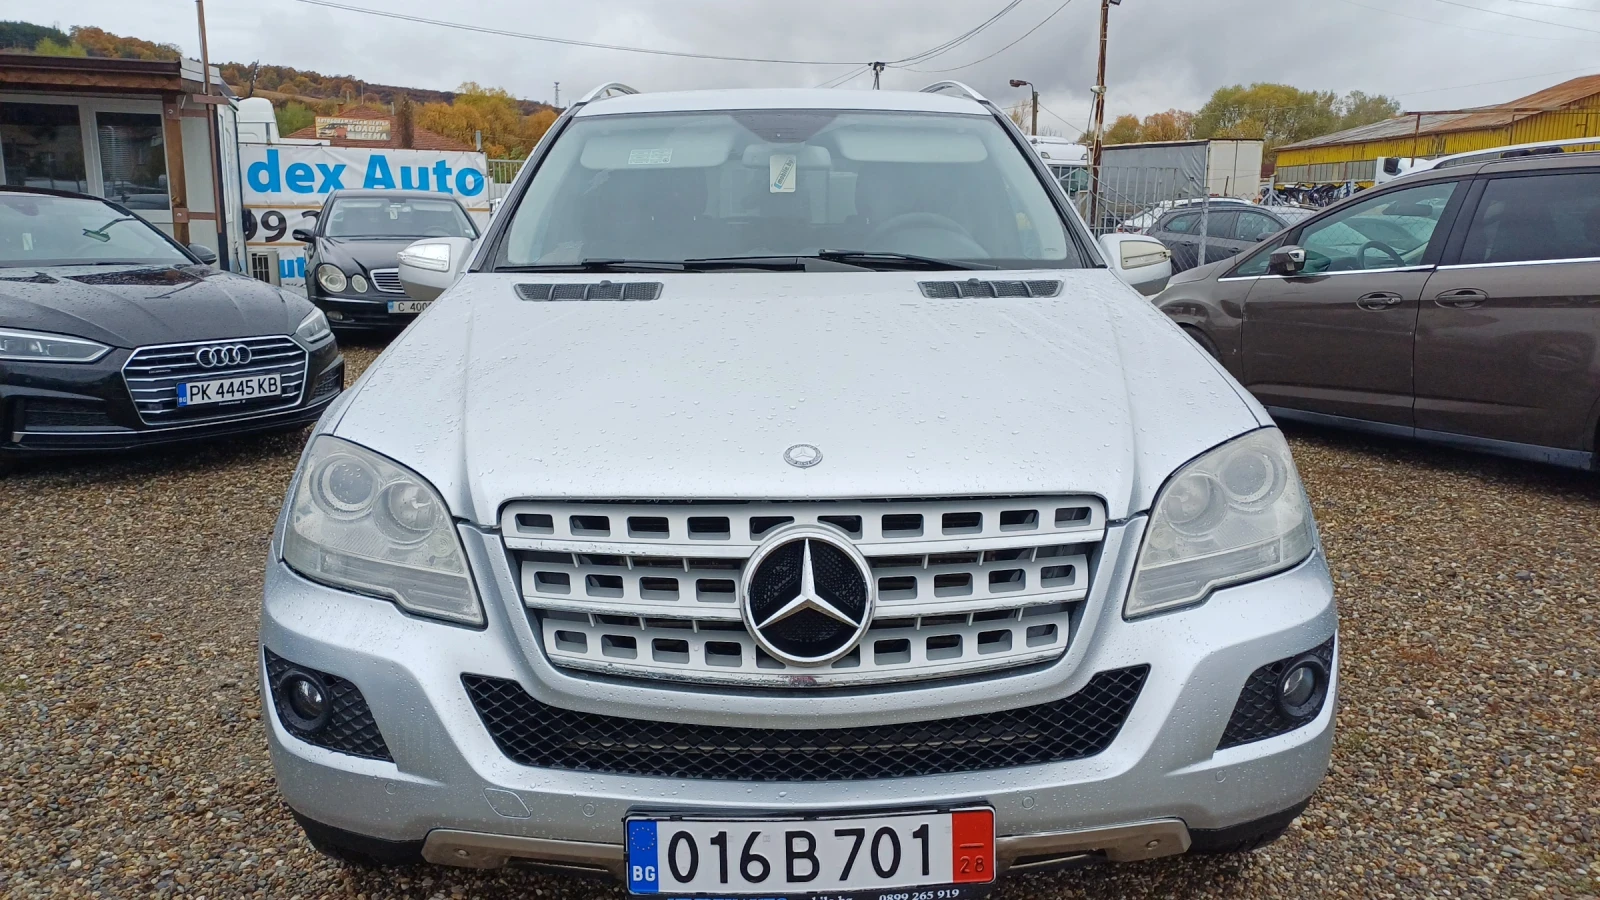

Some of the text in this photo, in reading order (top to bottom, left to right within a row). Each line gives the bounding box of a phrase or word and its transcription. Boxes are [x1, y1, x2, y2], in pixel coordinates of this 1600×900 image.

[347, 124, 383, 132] КОЛОР
[361, 132, 387, 140] СТИЛ
[247, 149, 485, 197] dex Auto
[410, 302, 432, 312] 400
[960, 855, 985, 873] 28
[632, 865, 656, 882] BG
[912, 891, 934, 900] 265
[937, 889, 960, 898] 919
